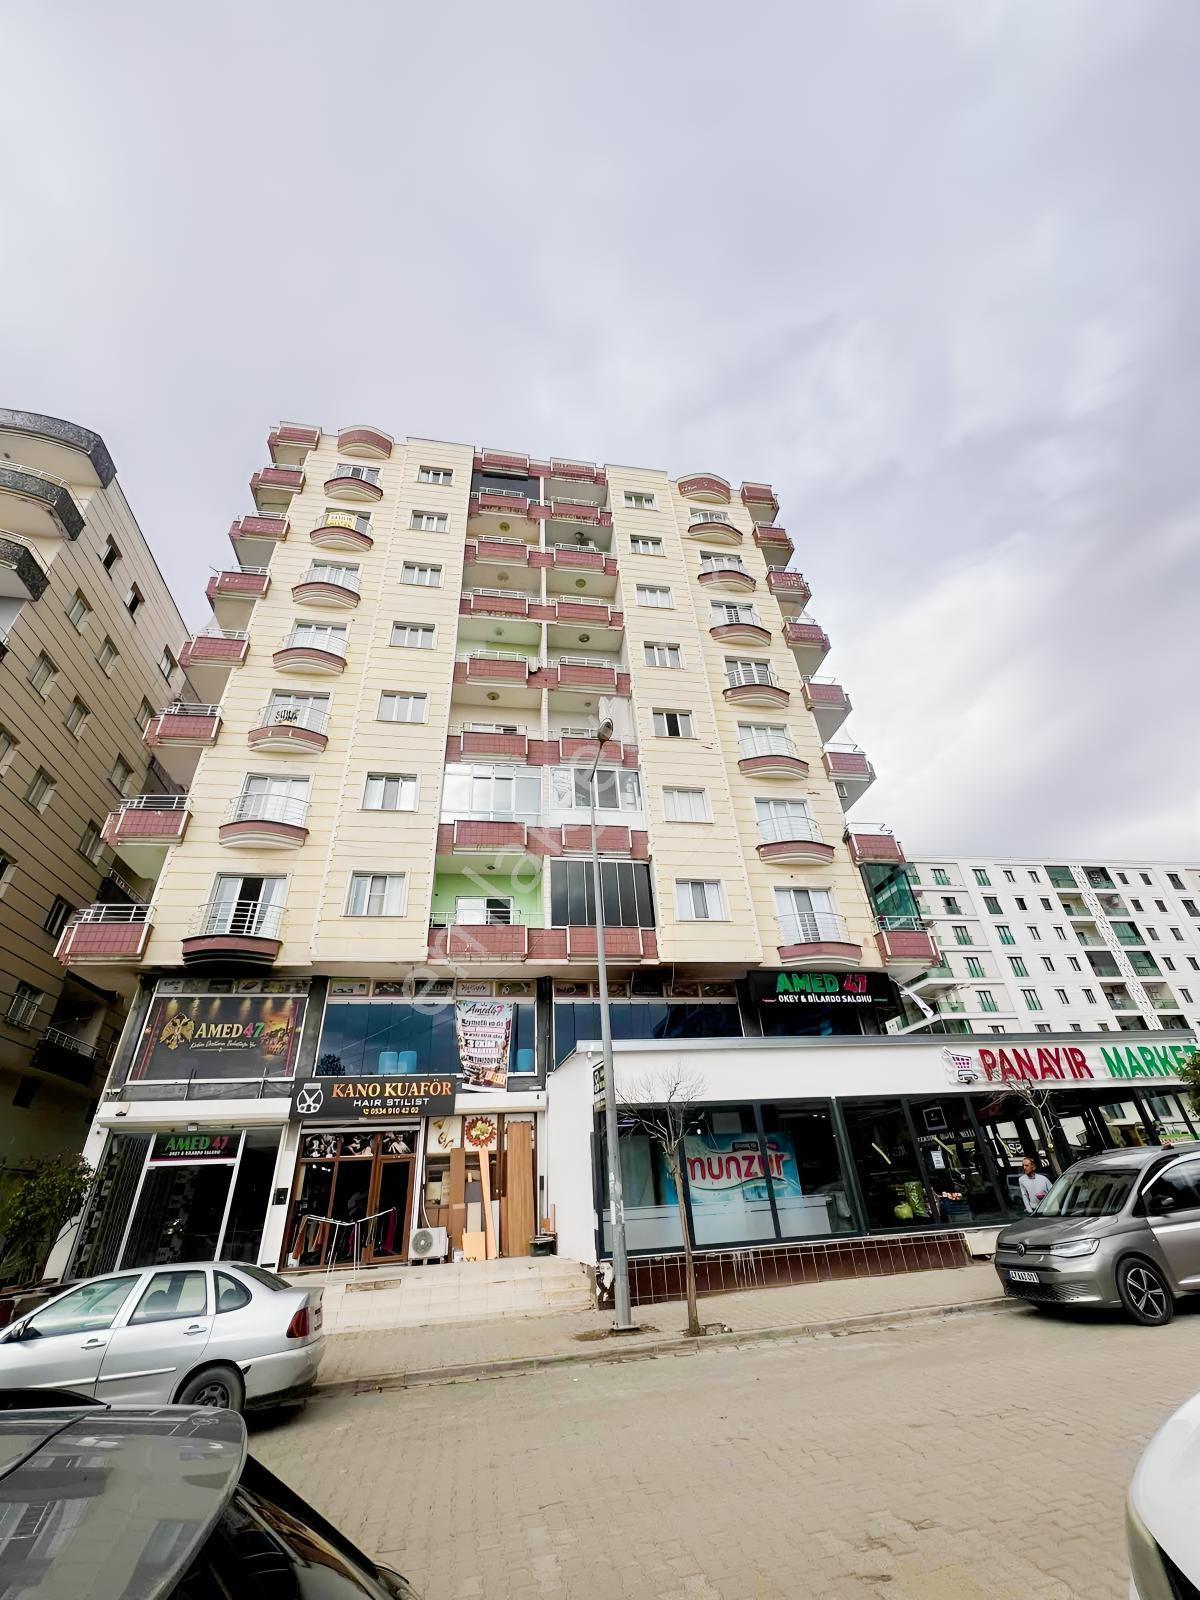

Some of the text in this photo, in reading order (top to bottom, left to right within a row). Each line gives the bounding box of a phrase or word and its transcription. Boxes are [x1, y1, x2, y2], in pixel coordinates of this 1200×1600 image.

[776, 973, 868, 993] AMED 47
[778, 994, 799, 1002] OKEY
[808, 993, 841, 1003] BİLARDO
[841, 995, 872, 1003] SALONU
[196, 1022, 265, 1038] AMED47
[978, 1047, 1095, 1082] PANAYIR
[331, 1079, 452, 1098] KANO KUAFÖR
[353, 1098, 429, 1107] HAIR STILIST
[165, 1136, 229, 1150] AMED 47
[687, 1153, 785, 1180] munzur
